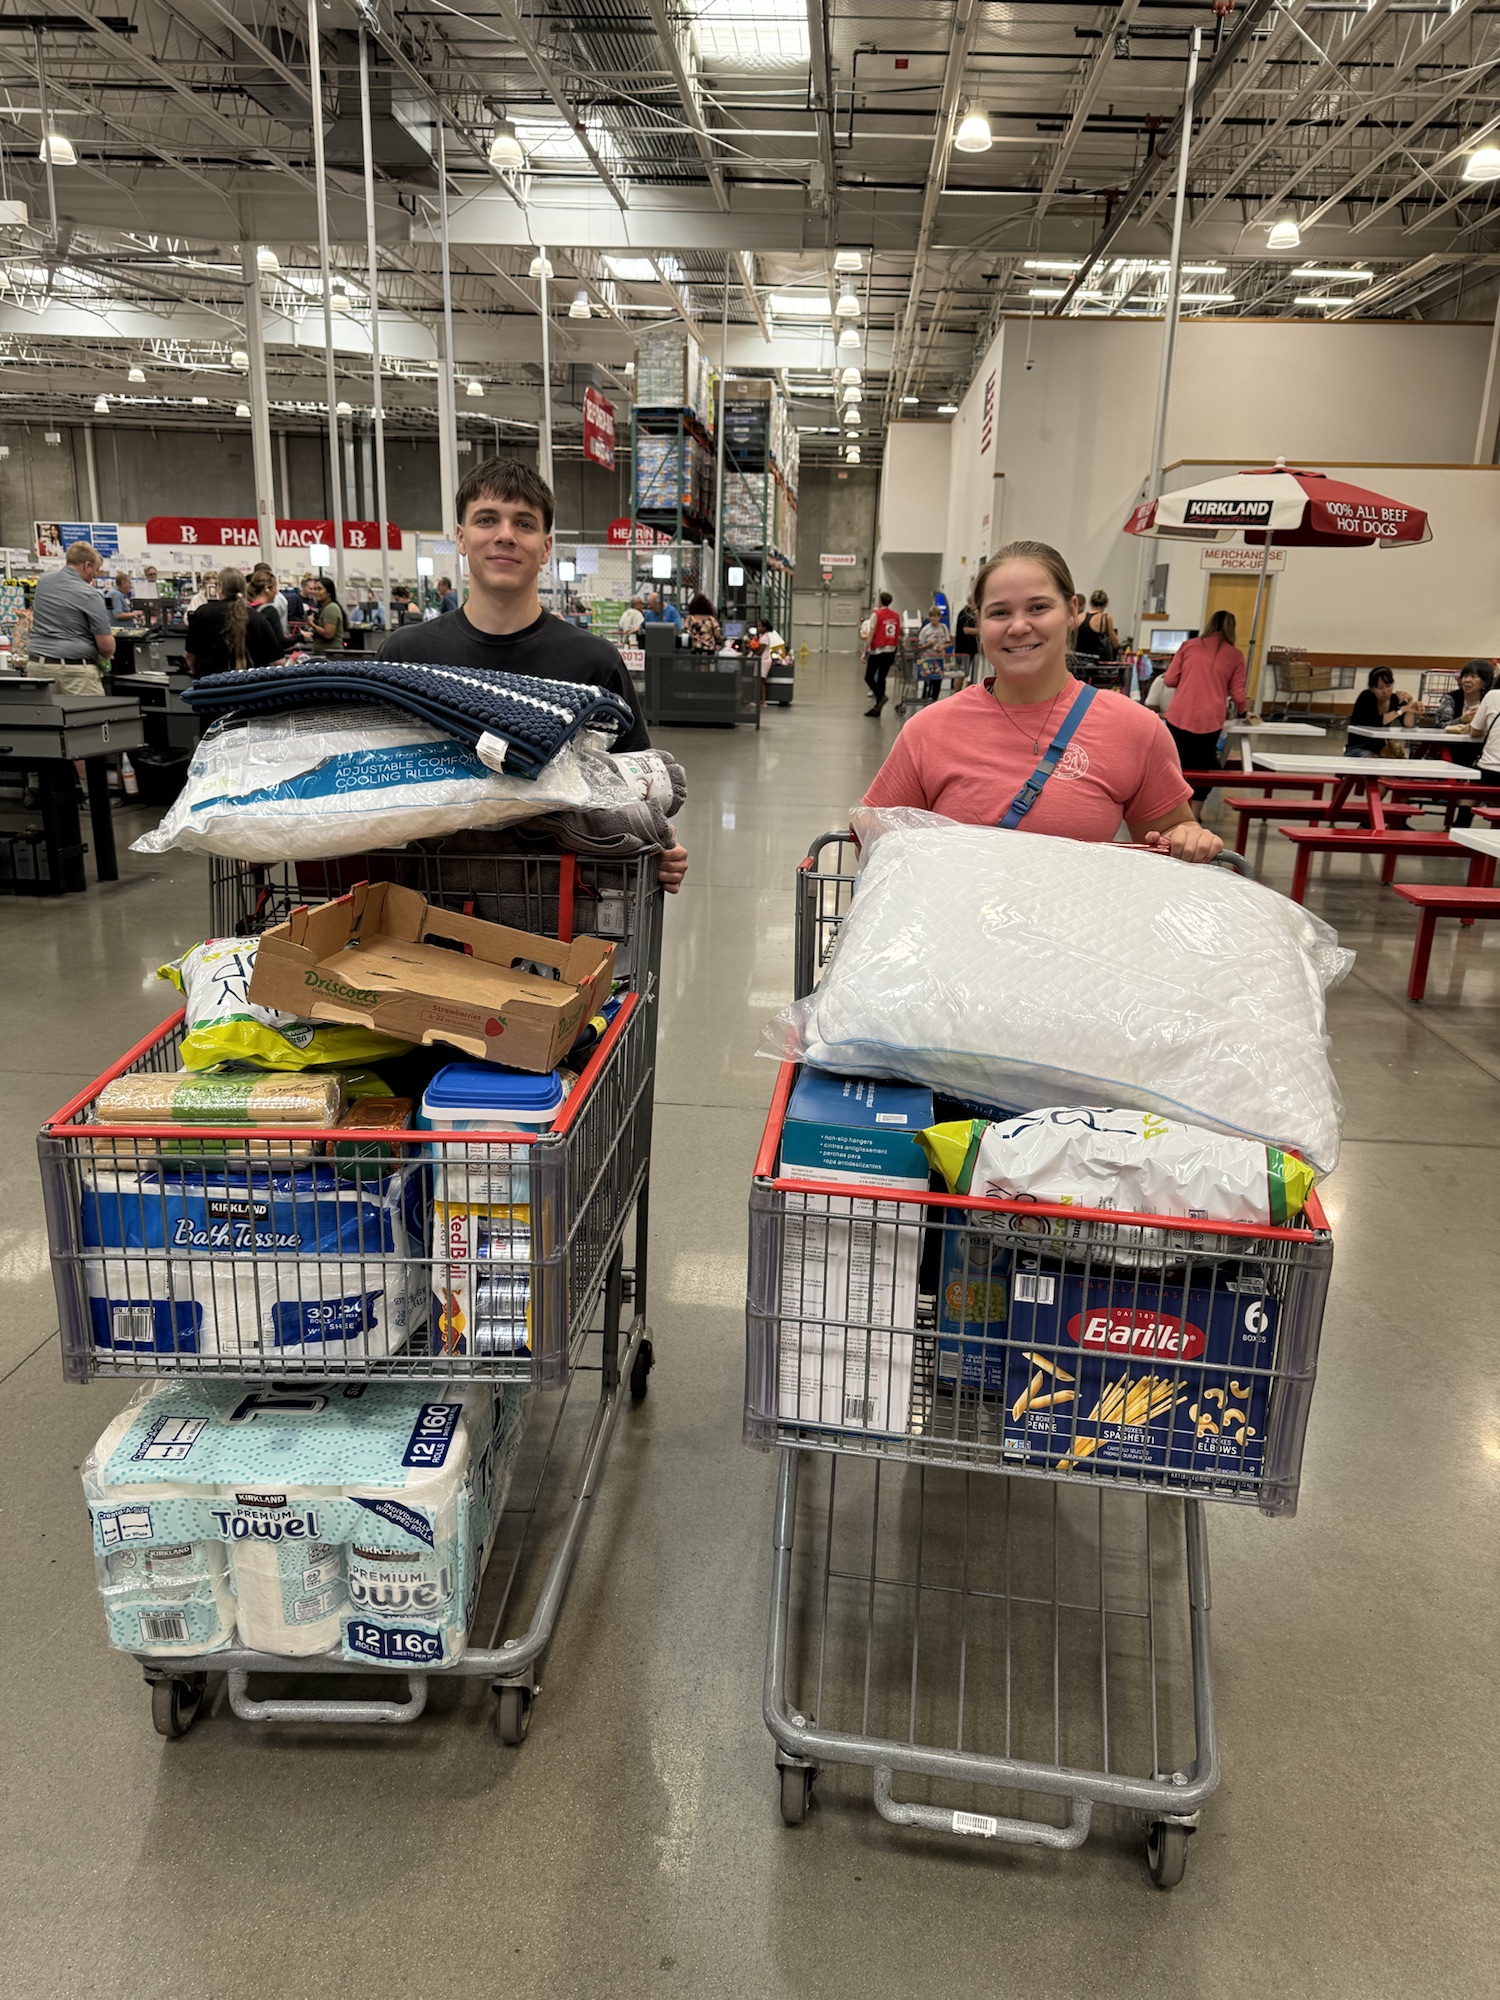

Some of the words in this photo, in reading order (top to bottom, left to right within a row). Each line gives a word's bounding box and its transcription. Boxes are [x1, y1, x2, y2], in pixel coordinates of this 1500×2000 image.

[1190, 502, 1269, 516] KIRKLAND
[1325, 502, 1353, 517] 100%
[1356, 505, 1379, 519] ALL
[1381, 507, 1408, 522] BEEF
[1337, 517, 1361, 532] HOT
[1363, 521, 1398, 536] DOGS
[220, 527, 323, 547] PHAMACY
[1204, 549, 1283, 561] MERCHANDSE
[335, 759, 414, 778] ADJUSTABLE
[335, 771, 401, 788] COOLING
[405, 766, 456, 779] PILLOW
[304, 970, 381, 1006] Driscoll's
[432, 1004, 482, 1021] Strawberries
[823, 1134, 848, 1143] non-slip
[849, 1136, 873, 1146] hangers
[823, 1142, 844, 1150] cintres
[822, 1150, 847, 1159] perchas
[174, 1218, 231, 1246] Bath
[234, 1222, 302, 1248] Tissue
[450, 1214, 467, 1244] Red
[306, 1306, 334, 1319] 30
[1244, 1301, 1269, 1334] 6
[1083, 1317, 1187, 1352] Barilla
[419, 1405, 450, 1436] 160
[409, 1443, 437, 1463] 12
[432, 1443, 446, 1464] ROLLS
[237, 1493, 285, 1504] KIRKLAND
[98, 1506, 150, 1519] Create-A-Size
[237, 1508, 292, 1521] PREMIUM
[384, 1502, 431, 1533] INDIVIDUALLY
[210, 1511, 319, 1541] Towel
[375, 1504, 410, 1527] WRAPPED
[410, 1523, 433, 1542] ROLLS
[150, 1546, 190, 1557] KIRKLAND
[353, 1566, 425, 1583] PREMIUM
[355, 1625, 381, 1648] 12
[355, 1640, 381, 1654] ROLLS
